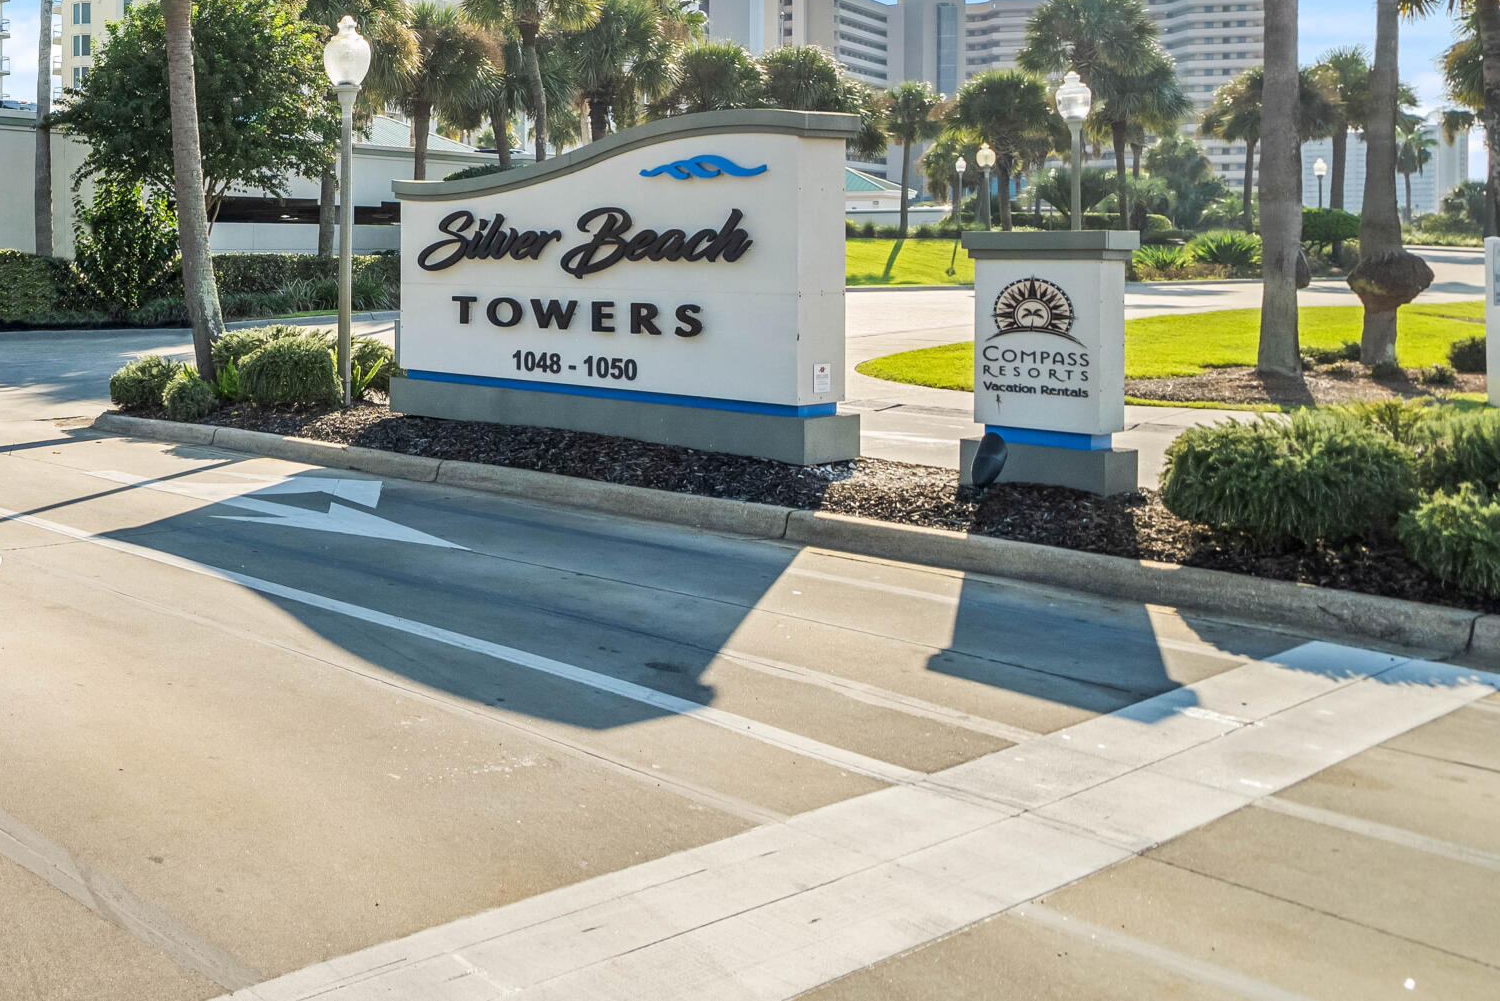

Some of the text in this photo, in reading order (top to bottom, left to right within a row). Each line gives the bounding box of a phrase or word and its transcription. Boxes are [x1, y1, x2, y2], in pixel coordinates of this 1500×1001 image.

[417, 207, 753, 279] Silver Beach
[452, 295, 704, 338] TOWERS
[512, 350, 562, 375] 1048
[583, 355, 638, 381] 1050
[982, 345, 1090, 368] COMPASS
[983, 364, 1089, 382] RESORTS
[983, 380, 1089, 398] Vacation Rentals
